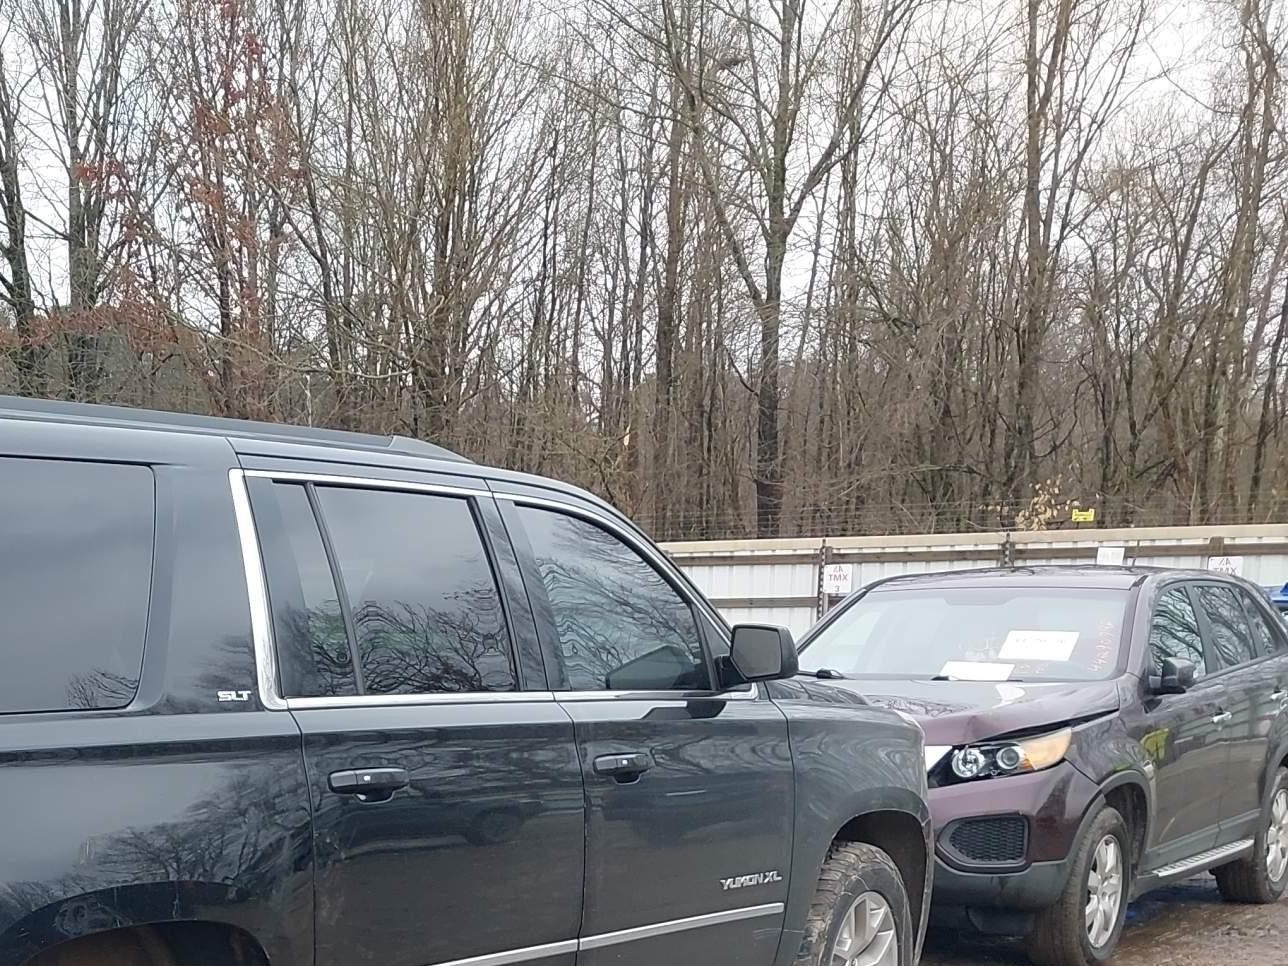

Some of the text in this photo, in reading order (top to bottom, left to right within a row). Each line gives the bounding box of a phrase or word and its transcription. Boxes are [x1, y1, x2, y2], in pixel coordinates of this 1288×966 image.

[828, 573, 849, 582] TMX
[834, 585, 840, 593] 3
[217, 690, 251, 702] SLT
[719, 870, 783, 890] YUKON XL
